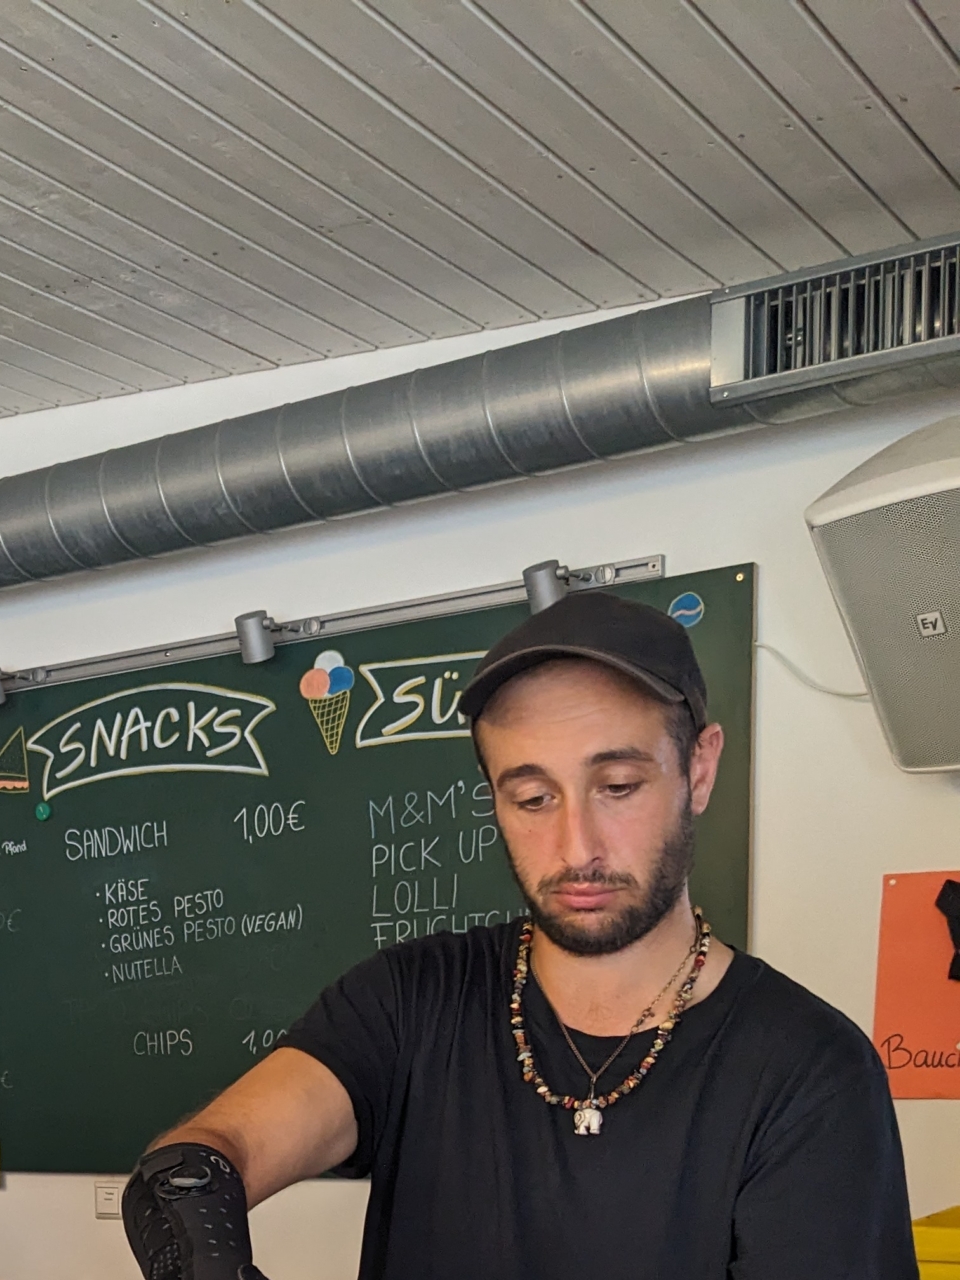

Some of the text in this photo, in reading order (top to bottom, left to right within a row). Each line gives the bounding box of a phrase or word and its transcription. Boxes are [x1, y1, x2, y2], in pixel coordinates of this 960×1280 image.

[381, 670, 466, 736] SÜ
[55, 701, 242, 779] SNACKS
[64, 800, 306, 861] SANDWICH 1,00€
[369, 780, 495, 839] M&M'S
[1, 839, 28, 856] Pfand
[372, 825, 498, 878] PICK UP
[105, 879, 149, 904] KÄSE
[107, 889, 224, 928] ROTES PESTO
[372, 873, 458, 917] LOLLI
[109, 903, 304, 953] GRÜNES PESTO (VEGAN)
[112, 955, 183, 984] NUTELLA
[133, 1029, 193, 1056] CHIPS
